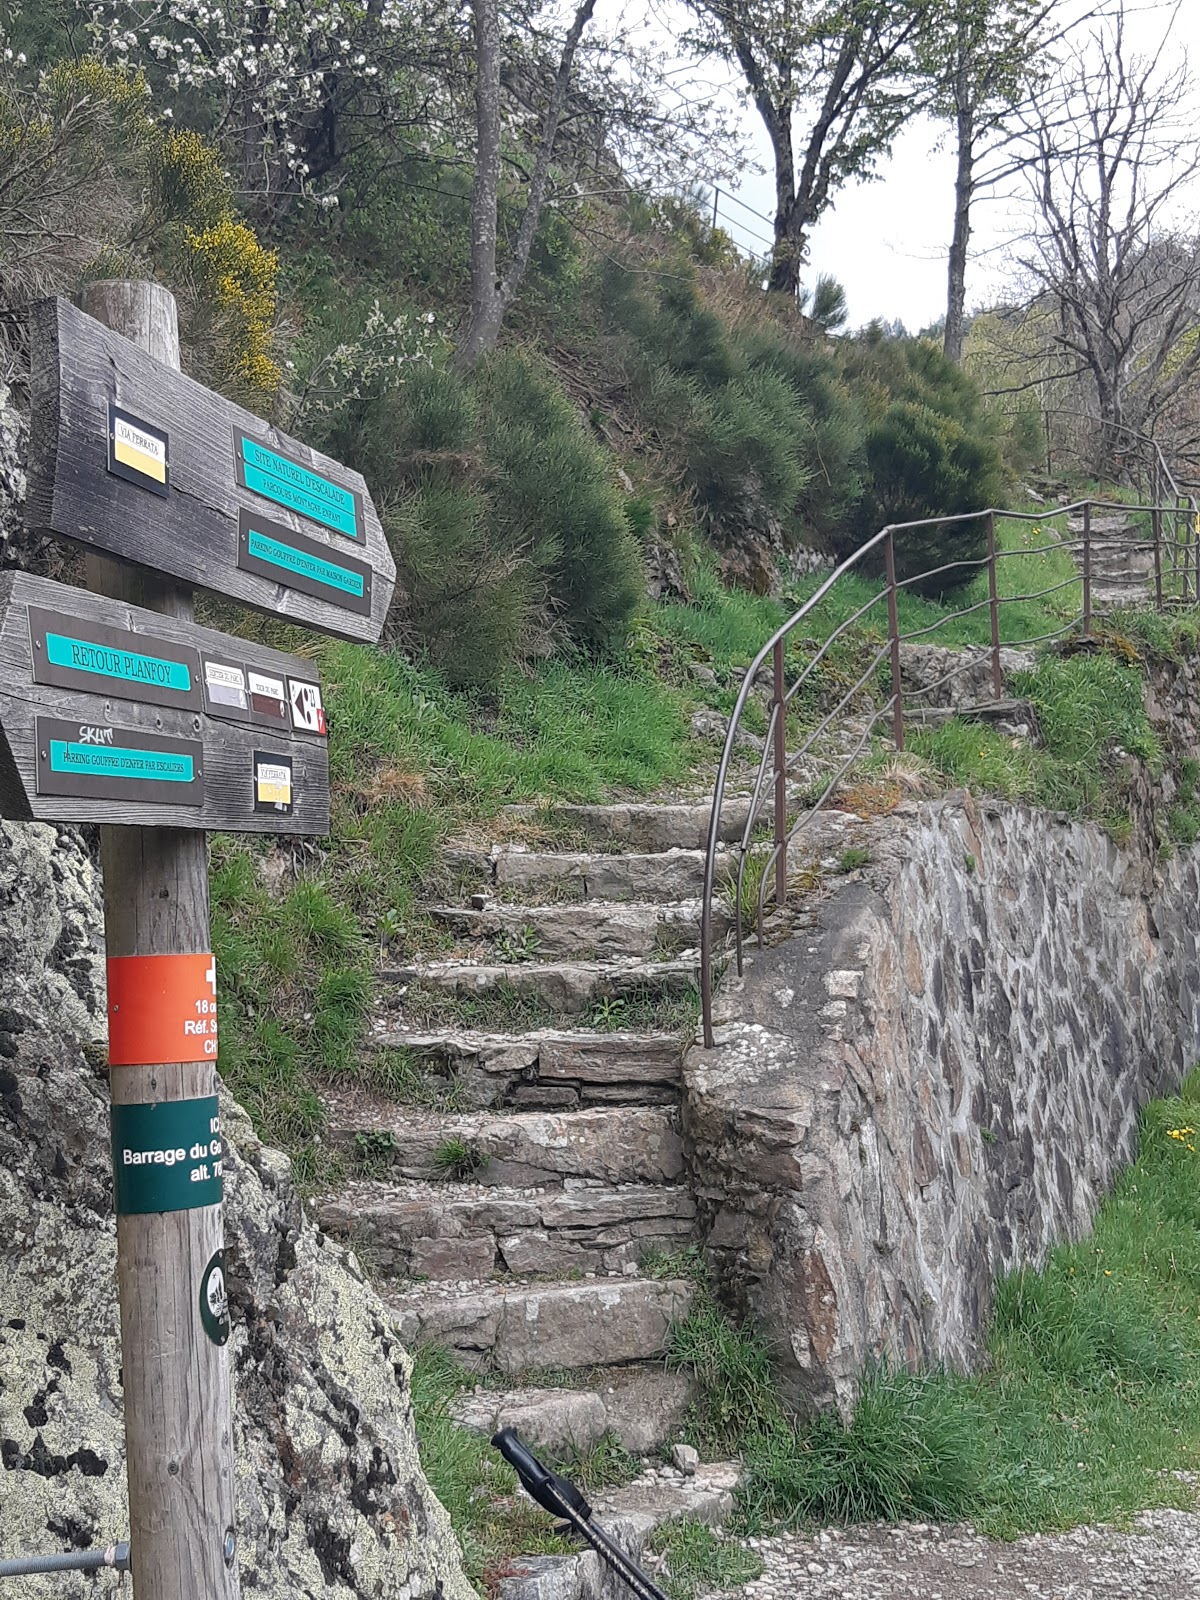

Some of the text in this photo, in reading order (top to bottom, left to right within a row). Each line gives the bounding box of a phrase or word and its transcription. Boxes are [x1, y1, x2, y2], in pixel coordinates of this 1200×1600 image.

[120, 426, 159, 456] VIA FERRATA
[254, 449, 346, 506] SITE NATUREL D'ESCALADE
[262, 478, 341, 524] PARCOURS MONTAGNE ENFANT
[250, 538, 273, 555] PARKING
[272, 547, 297, 566] GOUFFRE
[316, 565, 326, 576] PAR
[325, 569, 343, 583] MAISON
[71, 644, 171, 684] RETOUR PLANFOY
[63, 751, 91, 765] PARKING
[91, 754, 120, 768] GOUFFRE
[144, 759, 156, 771] PAR
[156, 761, 184, 774] ESCALIERS
[195, 999, 209, 1014] 18
[184, 1019, 209, 1036] Réf.
[122, 1147, 187, 1166] Barrage
[189, 1142, 208, 1159] du
[190, 1163, 211, 1182] alt.
